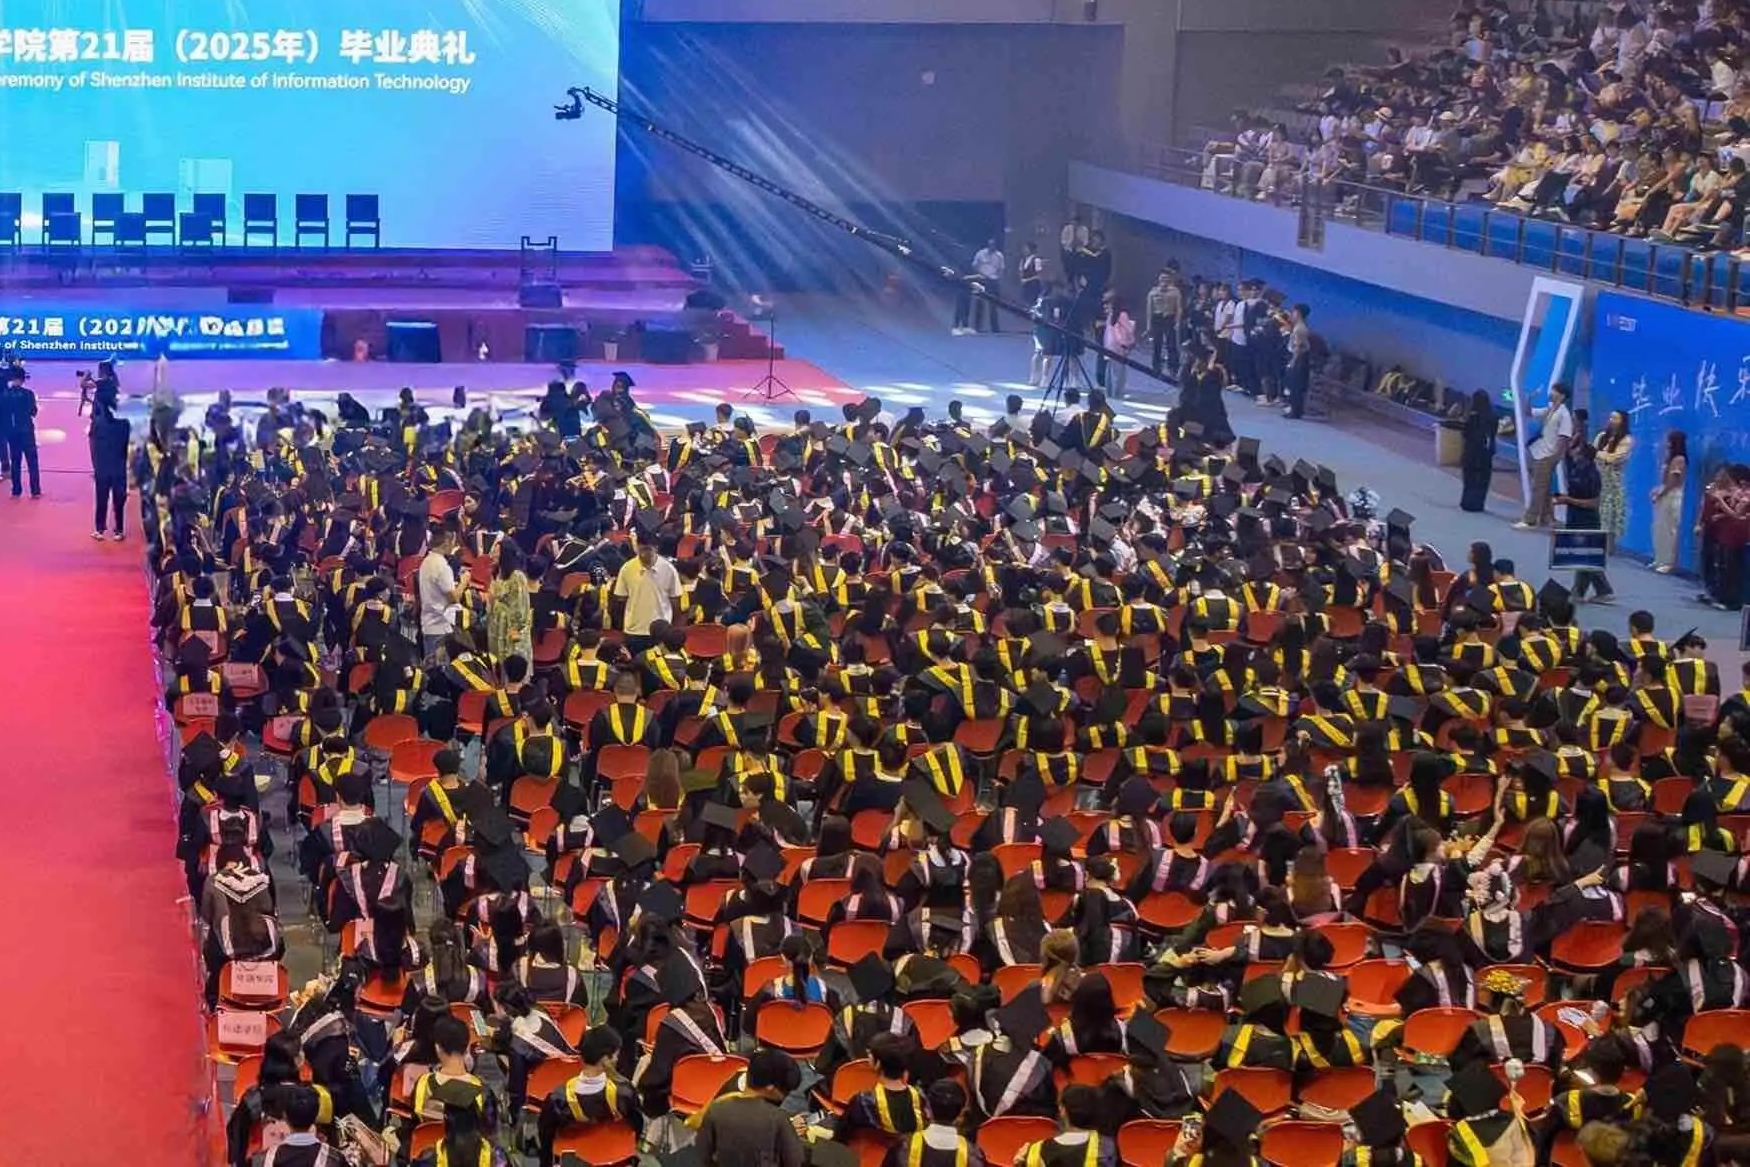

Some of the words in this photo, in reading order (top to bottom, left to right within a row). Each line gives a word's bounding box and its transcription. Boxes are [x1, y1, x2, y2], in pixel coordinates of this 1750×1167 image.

[68, 71, 88, 88] of
[90, 70, 172, 88] Shenzhen
[177, 70, 246, 88] Institute
[250, 71, 269, 88] of
[273, 71, 370, 89] Information
[375, 71, 471, 94] Technology
[4, 339, 17, 350] of
[20, 339, 76, 350] Shenzhen
